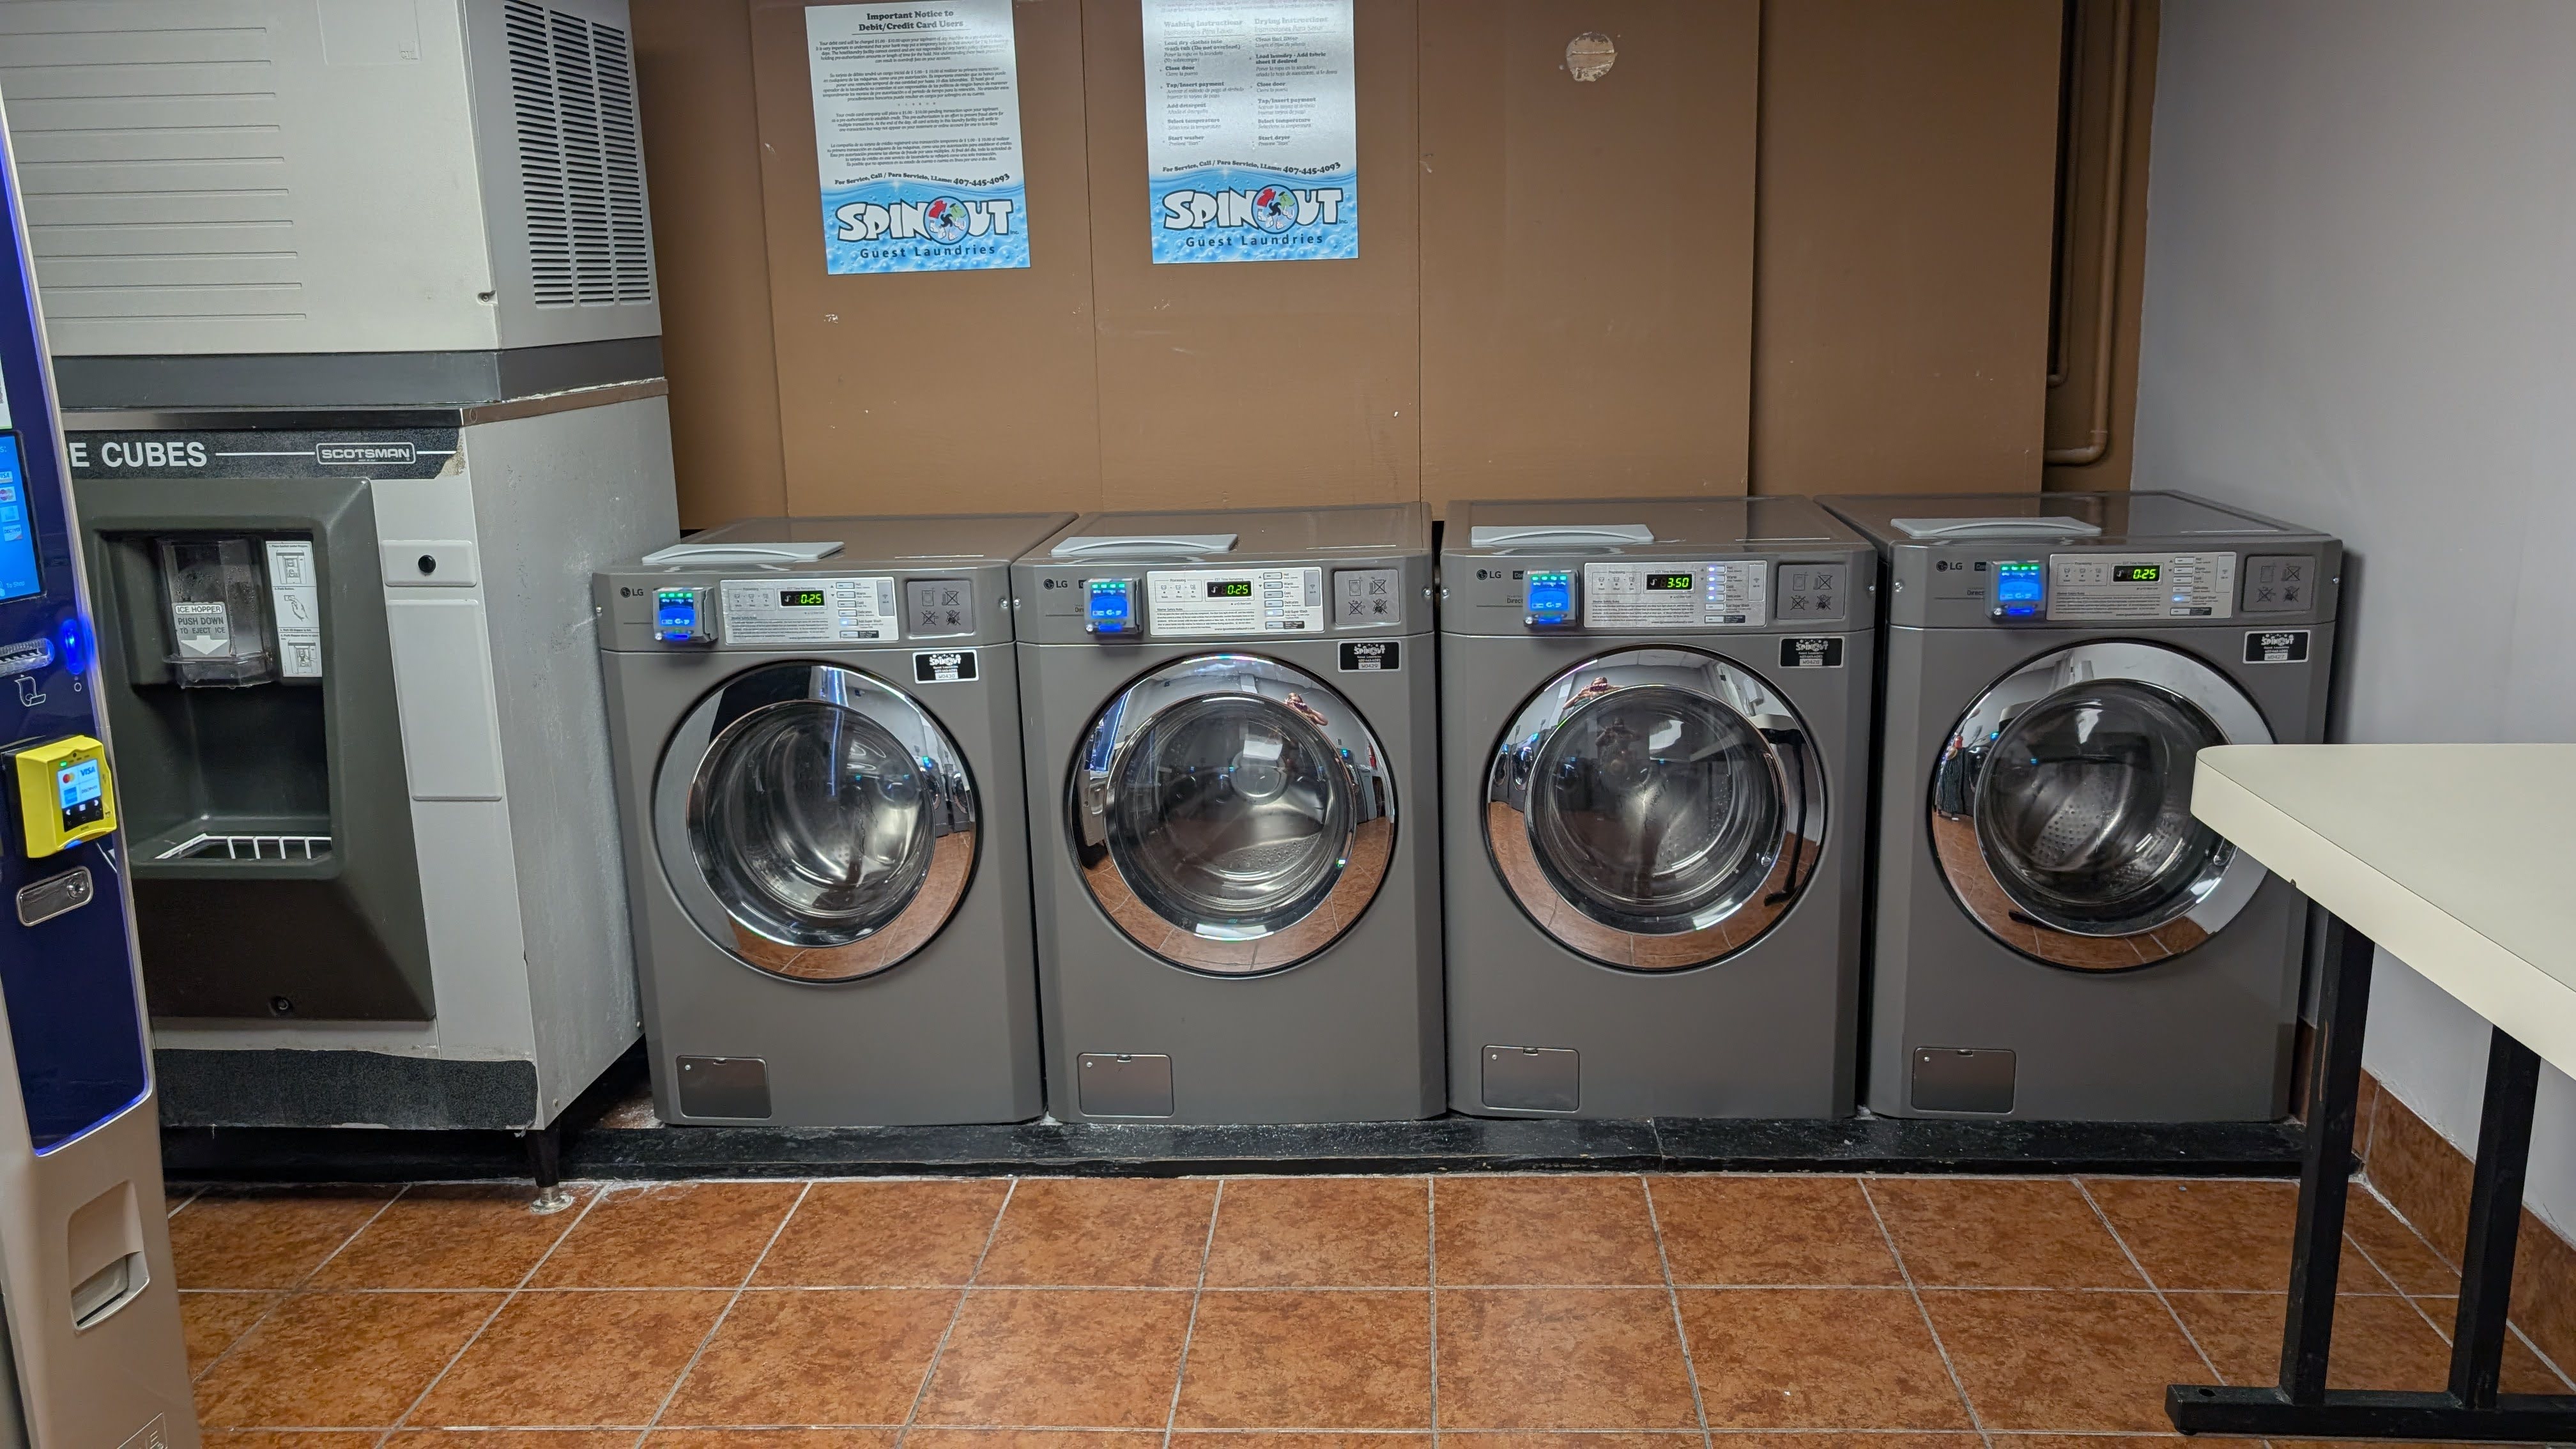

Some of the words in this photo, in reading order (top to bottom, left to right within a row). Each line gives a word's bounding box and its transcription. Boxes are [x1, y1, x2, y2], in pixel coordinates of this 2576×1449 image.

[859, 22, 914, 31] Debit/Credit
[916, 20, 937, 29] Card
[1174, 164, 1198, 172] Service,
[1232, 160, 1259, 169] Servicio,
[1260, 163, 1282, 172] LLame:
[1282, 162, 1340, 175] 407-445-4093
[847, 176, 870, 185] Service,
[903, 172, 929, 181] Servicio,
[953, 173, 1010, 187] 407-445-4093
[1163, 184, 1343, 234] SPINOUT
[835, 195, 1014, 245] SPINOUT
[1186, 236, 1232, 247] Guest
[1241, 234, 1323, 245] Laundries
[860, 247, 906, 258] Guest
[915, 245, 996, 257] Laundries
[66, 443, 89, 468] E
[102, 442, 208, 468] CUBES
[321, 448, 410, 459] SCOTSMAN
[1950, 562, 1963, 571] LG
[1489, 571, 1502, 579] LG
[1056, 580, 1068, 588] LG
[178, 617, 198, 625] PUSH
[80, 766, 96, 776] VISA
